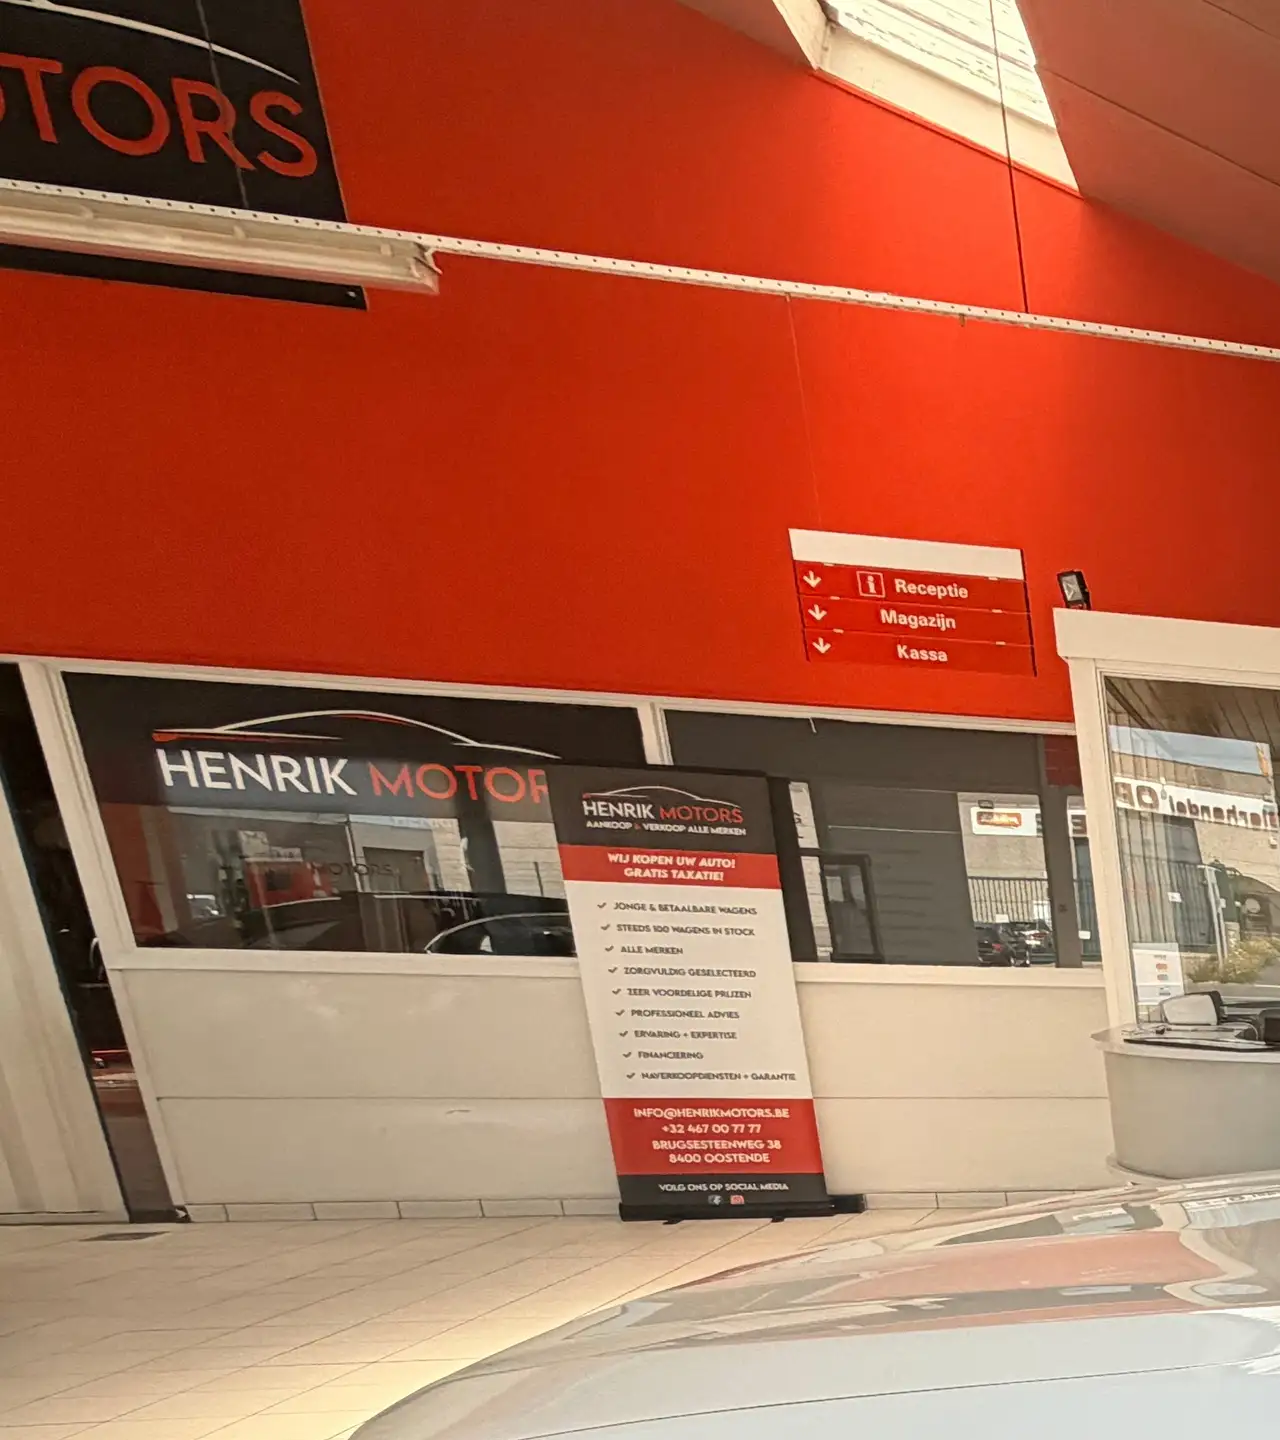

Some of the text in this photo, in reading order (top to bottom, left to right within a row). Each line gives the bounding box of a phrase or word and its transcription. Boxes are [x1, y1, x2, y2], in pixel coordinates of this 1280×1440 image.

[0, 52, 318, 177] TORS
[894, 578, 969, 599] Receptie
[879, 608, 957, 631] Magazijn
[896, 644, 948, 662] Kassa
[156, 749, 358, 796] HENRIK
[582, 800, 744, 824] HENRIK MOTORS
[586, 821, 633, 830] AANKOOP
[643, 823, 686, 832] VERKOOP
[688, 825, 709, 834] ALLE
[711, 827, 747, 836] MERKEN
[608, 853, 736, 868] WIJ KOPEN UW AUTO!
[624, 868, 724, 881] GRATIS TAXATIE!
[613, 902, 647, 911] JONGE
[659, 904, 716, 914] BETAALBARE
[718, 906, 757, 915] WAGENS
[616, 924, 651, 933] STEEDS
[672, 926, 710, 935] WAGENS
[724, 928, 755, 936] STOCK
[620, 945, 683, 955] ALLE MERKEN
[623, 966, 756, 978] ZORGVULDIG GESELECTEERD
[627, 988, 751, 999] ZEER VOORDELIGE PRIJZEN
[631, 1009, 740, 1019] PROFESSIONEEL ADVIES
[634, 1030, 681, 1039] ERVARING
[691, 1031, 737, 1040] EXPERTISE
[638, 1051, 704, 1060] FINANCIERING
[641, 1072, 741, 1081] NAVERKOOPDIENSTEN
[751, 1073, 797, 1081] GARANTIE
[633, 1107, 790, 1119] INFO@HENRIKMOTORS.BE
[662, 1123, 761, 1133] +32 467 00 77 77
[652, 1139, 782, 1150] BRUGSESTEENWEG 38
[669, 1153, 770, 1163] 8400 OOSTENDE
[659, 1183, 789, 1192] VOLG ONS OP SOCIAL MEDIA
